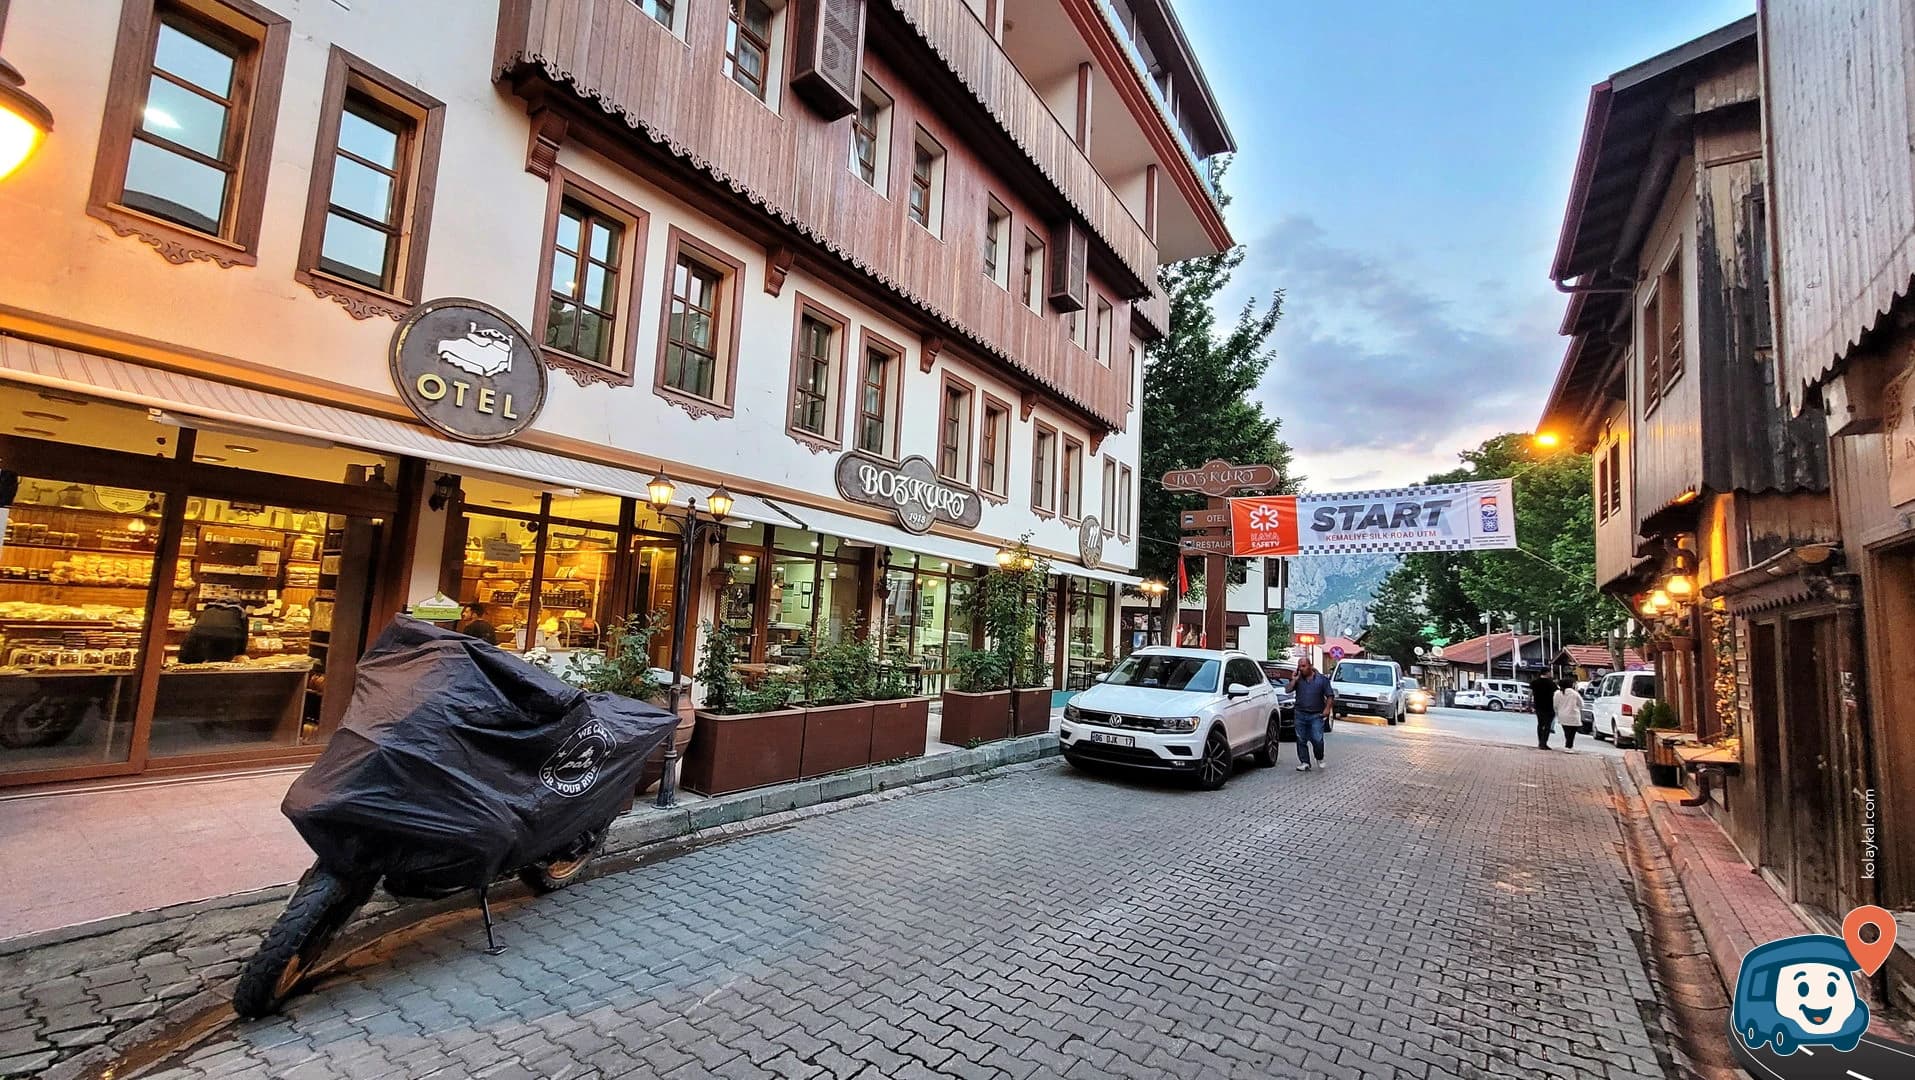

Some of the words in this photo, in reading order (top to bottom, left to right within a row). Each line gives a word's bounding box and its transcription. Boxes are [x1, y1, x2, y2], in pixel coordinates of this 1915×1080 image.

[416, 373, 518, 420] OTEL
[858, 464, 970, 520] BOZKURT
[908, 512, 926, 524] 1918
[1206, 514, 1226, 523] OTEL
[1310, 500, 1452, 532] START
[1369, 531, 1388, 540] SILK
[1390, 531, 1414, 539] ROAD
[1417, 530, 1437, 538] UTM
[557, 782, 581, 794] YOUR
[581, 765, 598, 788] RIDE
